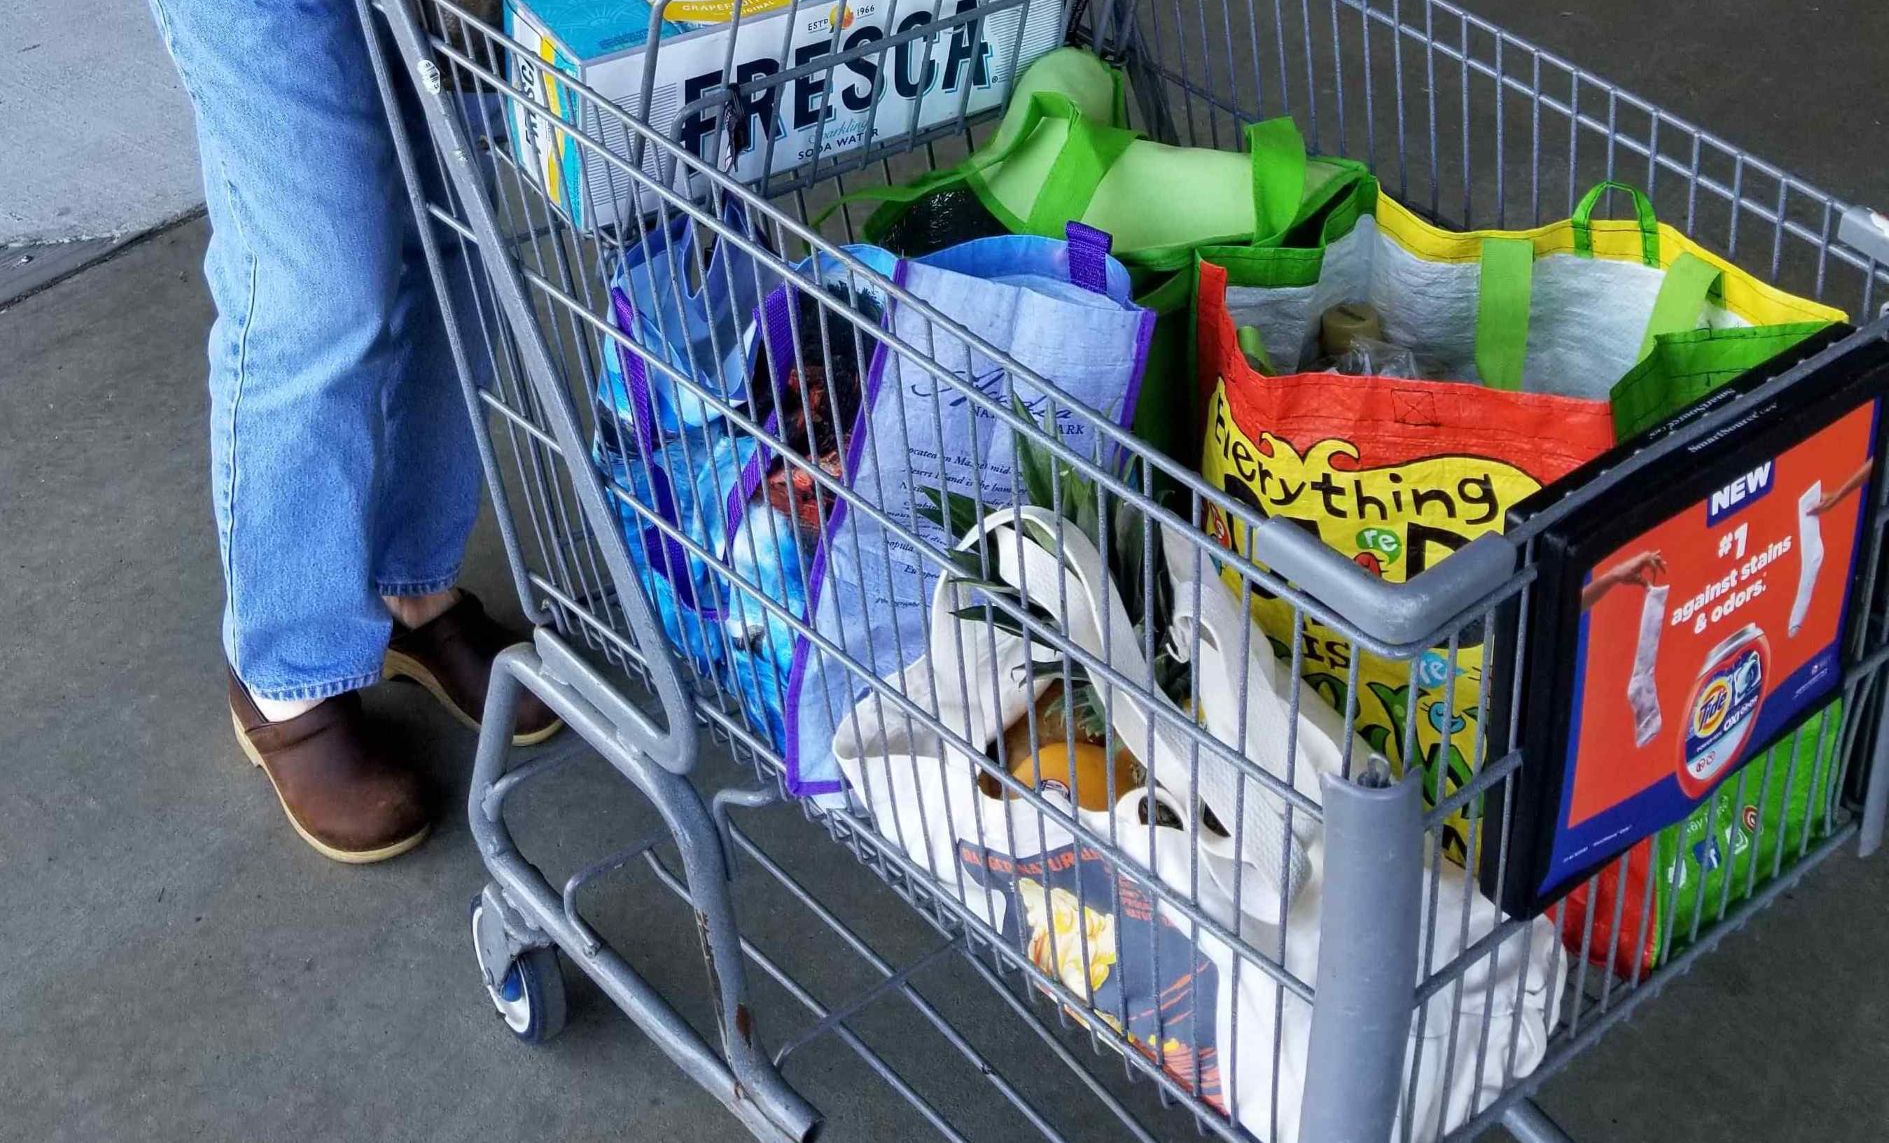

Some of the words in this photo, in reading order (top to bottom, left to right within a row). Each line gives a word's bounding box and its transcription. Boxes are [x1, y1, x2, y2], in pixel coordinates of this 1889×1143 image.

[856, 4, 875, 16] 1966
[836, 128, 879, 148] WATR
[1058, 423, 1084, 436] ARK
[1687, 410, 1759, 453] SmartSource
[1215, 392, 1498, 525] Everything
[1711, 460, 1771, 516] NEW
[1718, 522, 1749, 560] #1
[1671, 569, 1738, 626] against
[1741, 536, 1793, 581] stains
[1694, 612, 1707, 634] &
[1698, 688, 1728, 732] Tide
[1723, 713, 1741, 731] OXI
